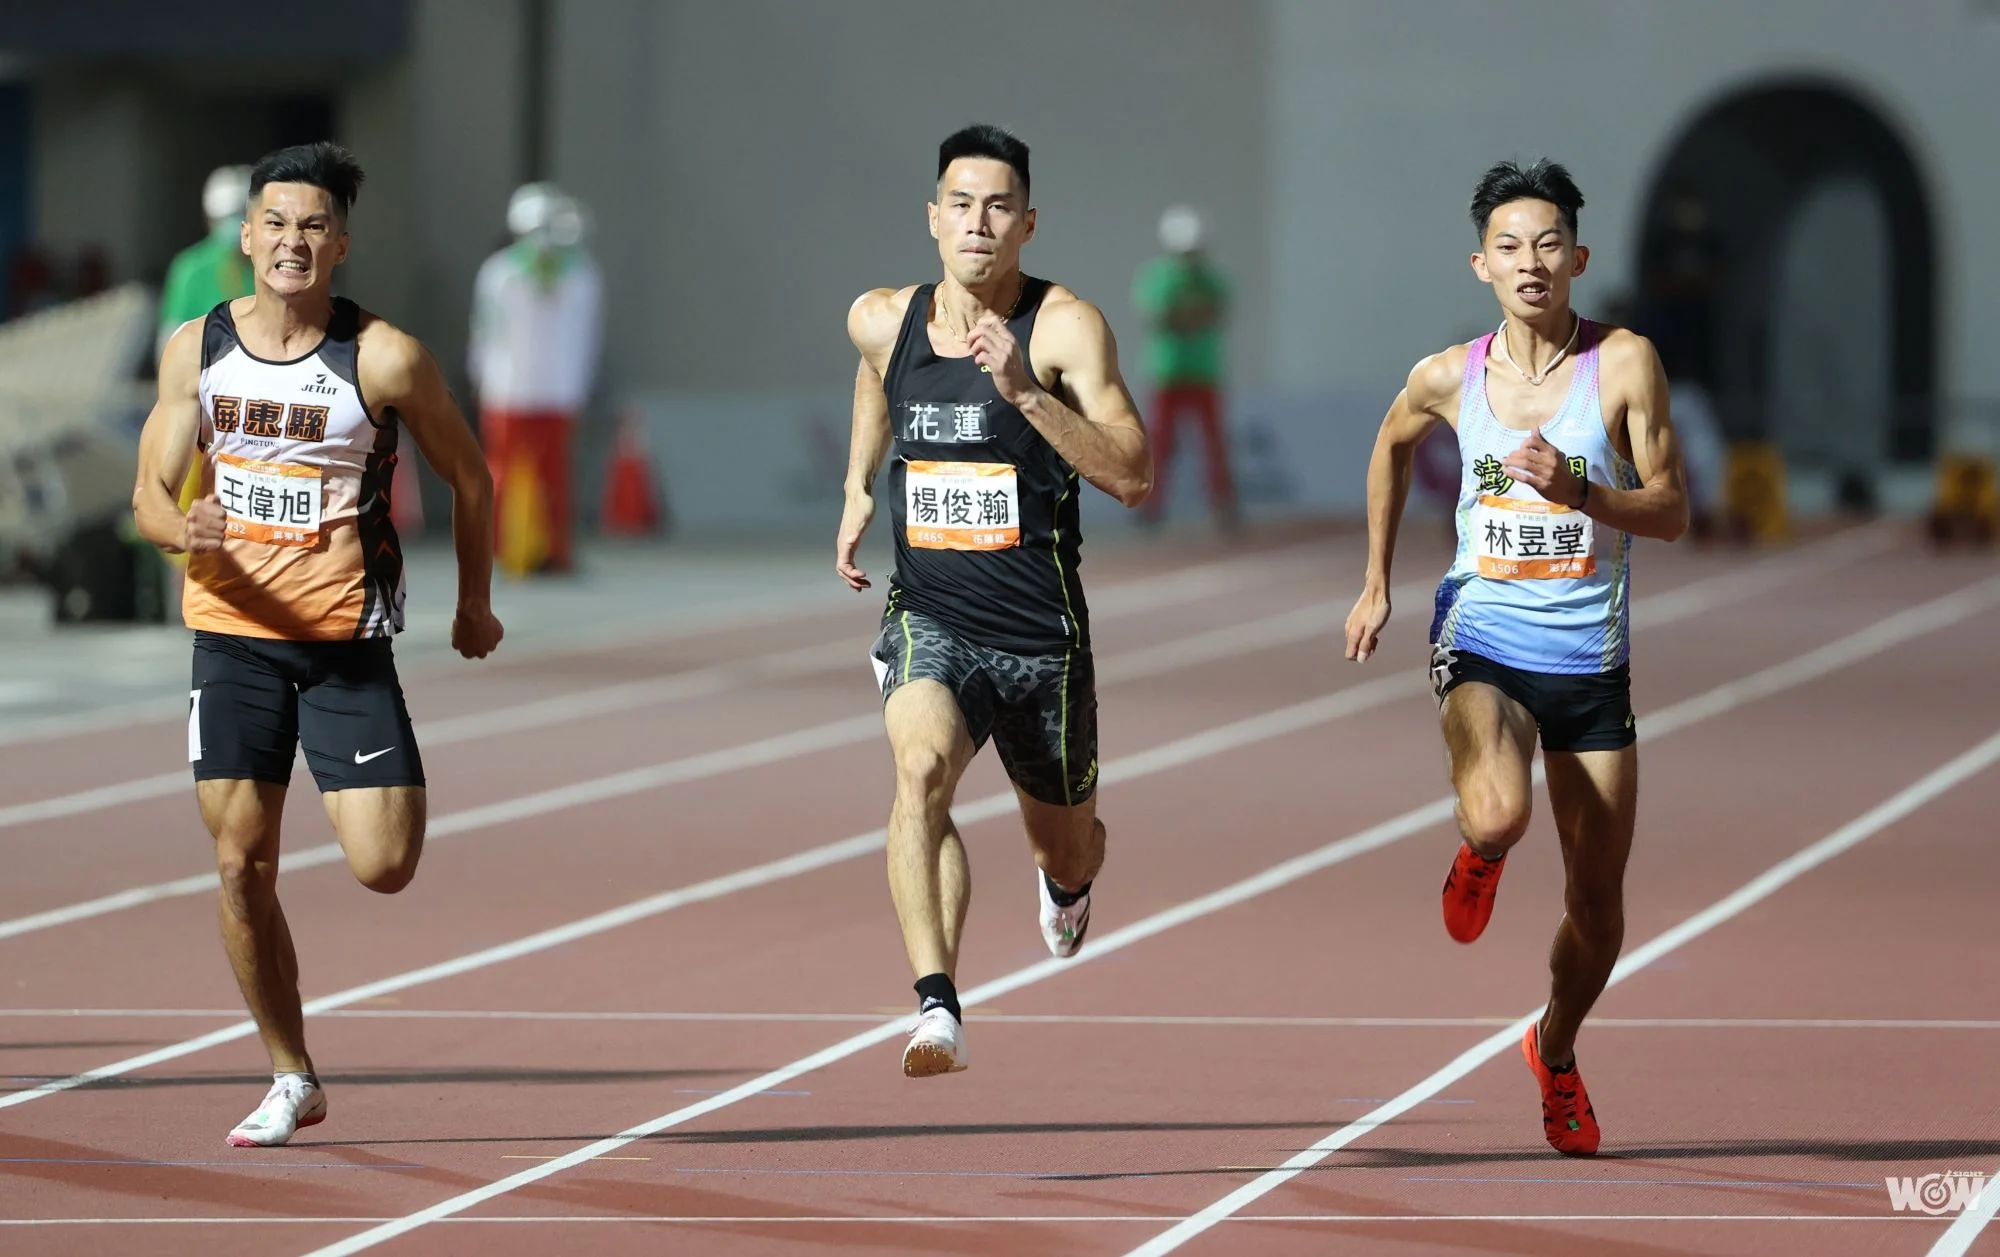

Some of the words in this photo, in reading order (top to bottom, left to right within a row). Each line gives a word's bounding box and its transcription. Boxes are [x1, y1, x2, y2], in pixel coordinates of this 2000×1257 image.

[301, 384, 339, 396] JETLIT
[212, 394, 330, 442] 屏東縣
[909, 403, 983, 441] 花蓮
[222, 475, 311, 524] 王偉旭
[912, 486, 1009, 525] 楊俊瀚
[1484, 519, 1586, 556] 林昱堂
[1490, 562, 1519, 574] 1506
